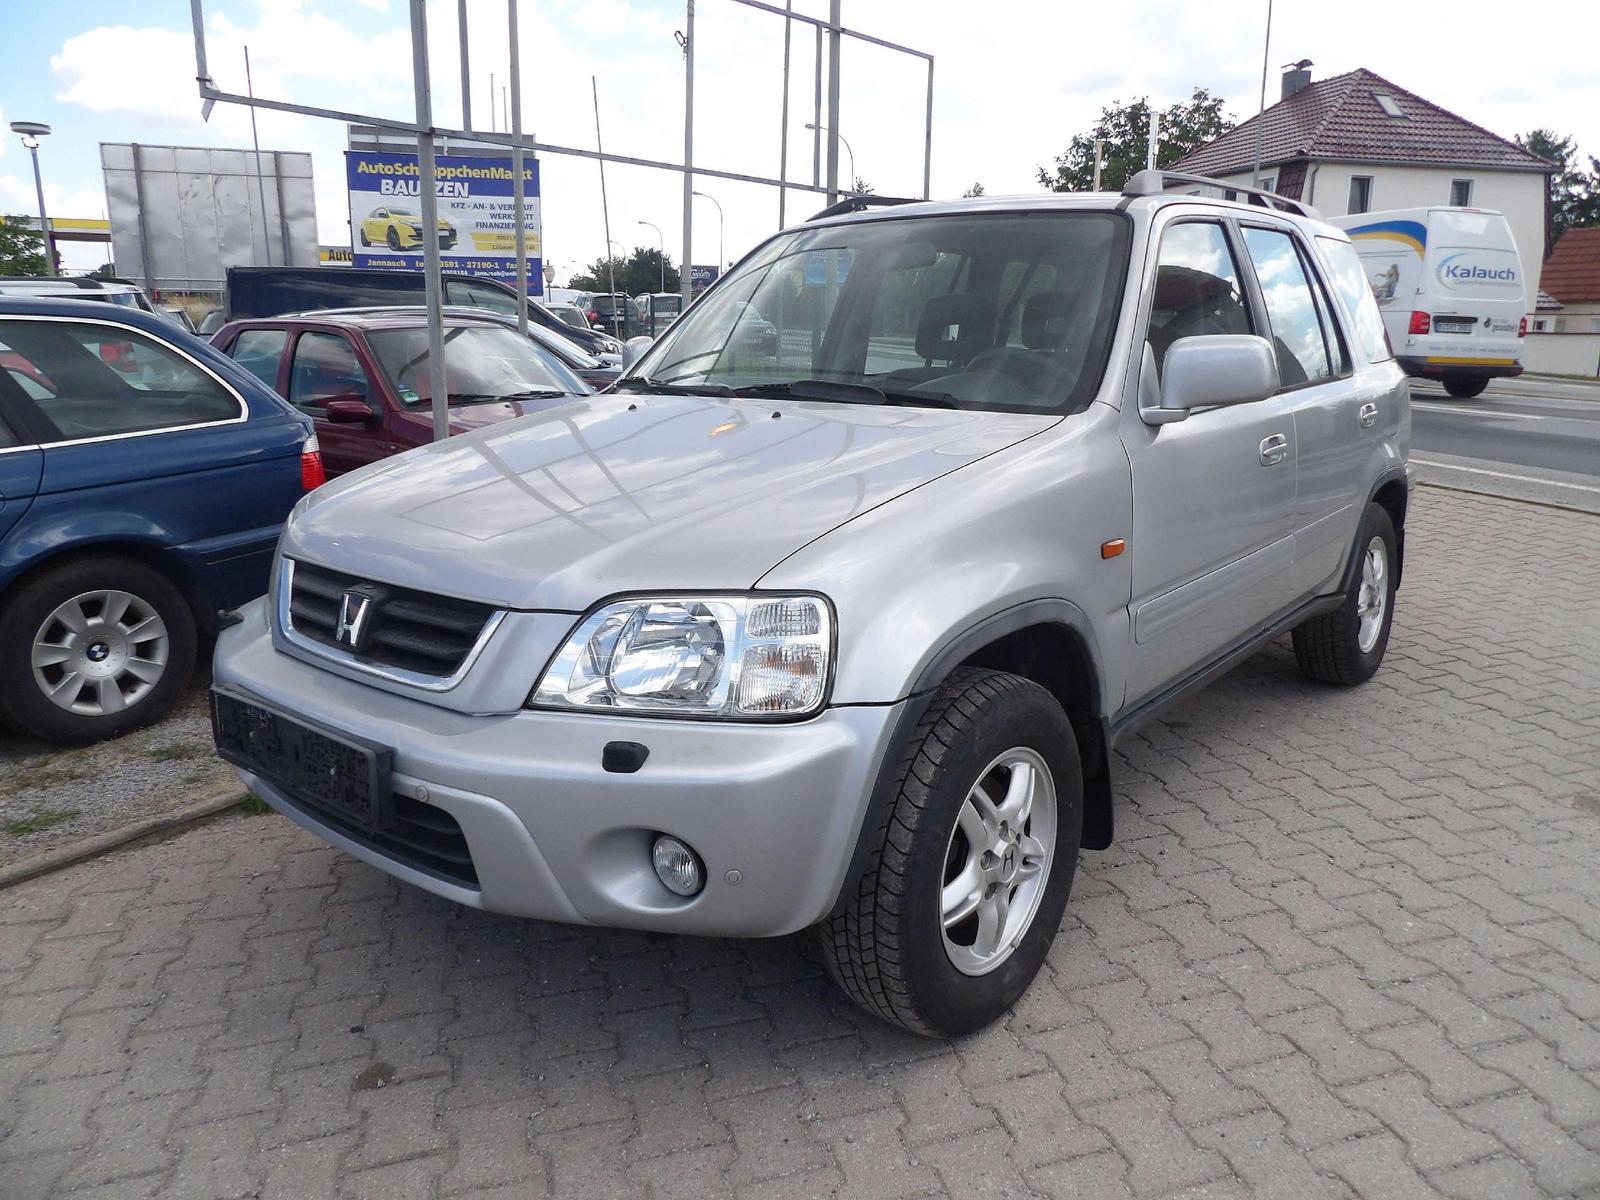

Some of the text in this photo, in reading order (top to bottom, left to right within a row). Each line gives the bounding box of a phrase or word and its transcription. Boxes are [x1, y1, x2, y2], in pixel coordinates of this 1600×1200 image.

[380, 178, 469, 198] BAUZEN
[475, 222, 534, 230] FINANZIERNG
[367, 259, 406, 267] Jannasch
[1446, 265, 1515, 280] Kalauch
